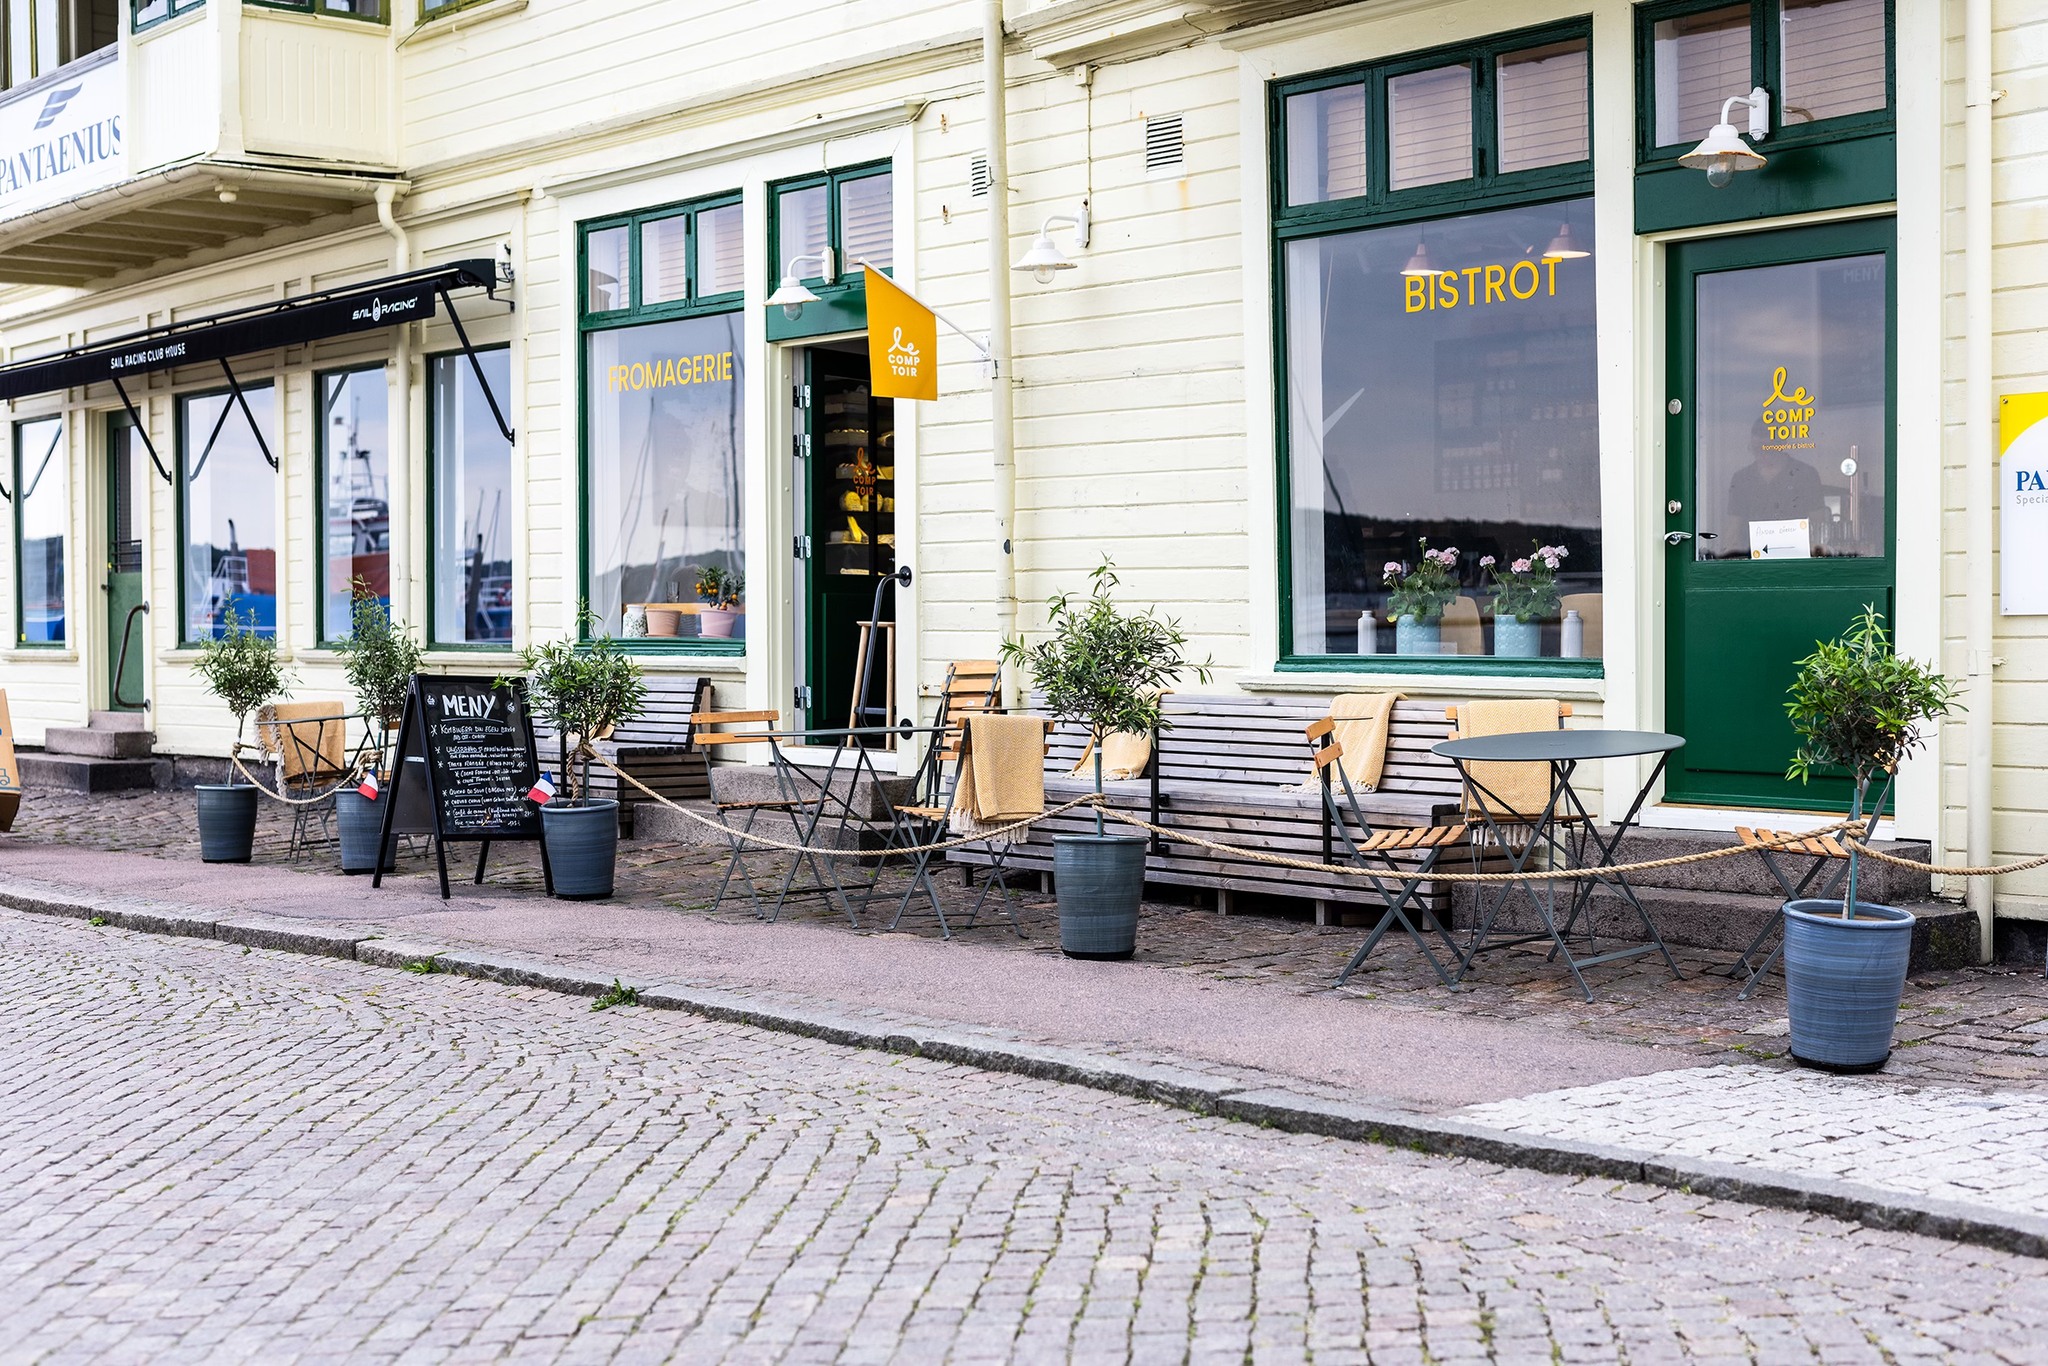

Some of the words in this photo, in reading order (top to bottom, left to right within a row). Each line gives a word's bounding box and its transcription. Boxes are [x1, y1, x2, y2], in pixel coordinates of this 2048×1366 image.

[1405, 256, 1563, 313] BISTROT
[352, 308, 372, 320] SAIL
[381, 299, 416, 315] RACING
[887, 326, 920, 356] le
[110, 356, 124, 370] SAIL
[124, 351, 147, 367] RACING
[147, 347, 164, 362] CLUB
[165, 342, 186, 359] HOUSE
[888, 354, 921, 366] COMP
[608, 351, 733, 394] FROMAGERIE
[891, 365, 917, 377] TOIR
[1762, 366, 1815, 407] le
[1762, 407, 1815, 424] COMP
[1767, 424, 1809, 440] TOIR
[852, 475, 876, 486] COMP
[855, 486, 875, 497] TOIR
[2015, 469, 2048, 492] PA
[441, 694, 497, 720] MENY
